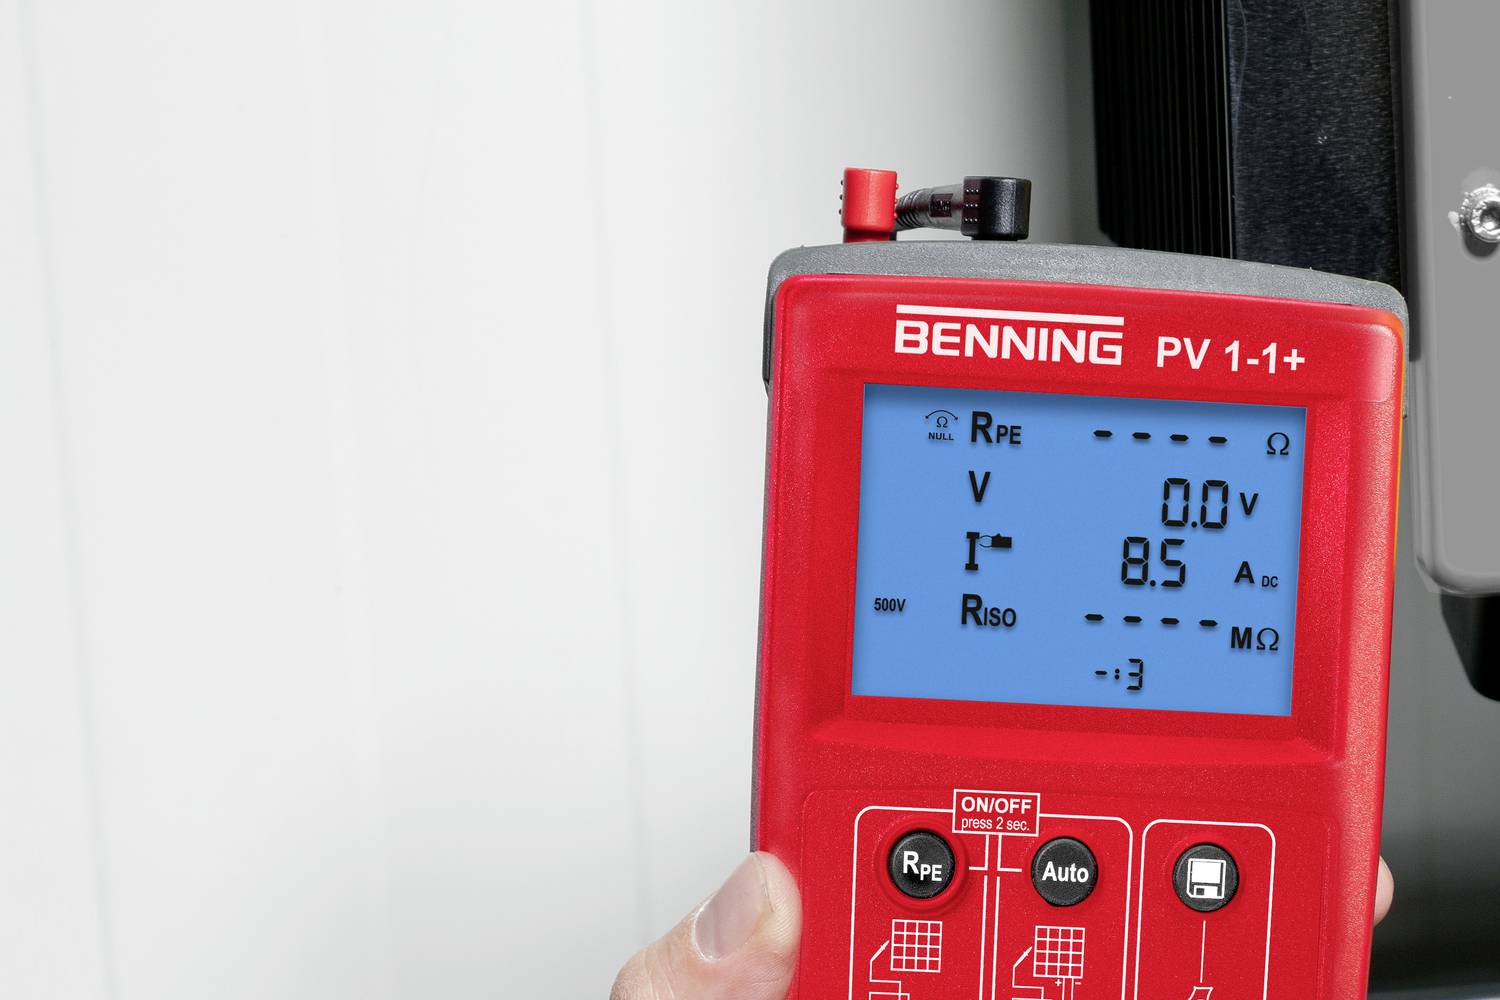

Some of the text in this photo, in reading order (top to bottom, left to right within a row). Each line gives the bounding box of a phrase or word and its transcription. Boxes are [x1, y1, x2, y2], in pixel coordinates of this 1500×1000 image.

[895, 319, 1306, 374] BENNING PV 1-1+
[928, 432, 954, 441] NULL
[970, 411, 1022, 445] RPE
[1266, 432, 1290, 455] Ω
[968, 470, 1259, 529] V 0.0 V
[965, 531, 1279, 588] I 8.5 A DC
[873, 597, 906, 612] 500V
[961, 593, 1017, 627] RISO
[961, 796, 1032, 815] ON/OFF
[961, 816, 1030, 831] press 2 sec.
[902, 850, 943, 882] RPE
[1042, 861, 1089, 882] Auto
